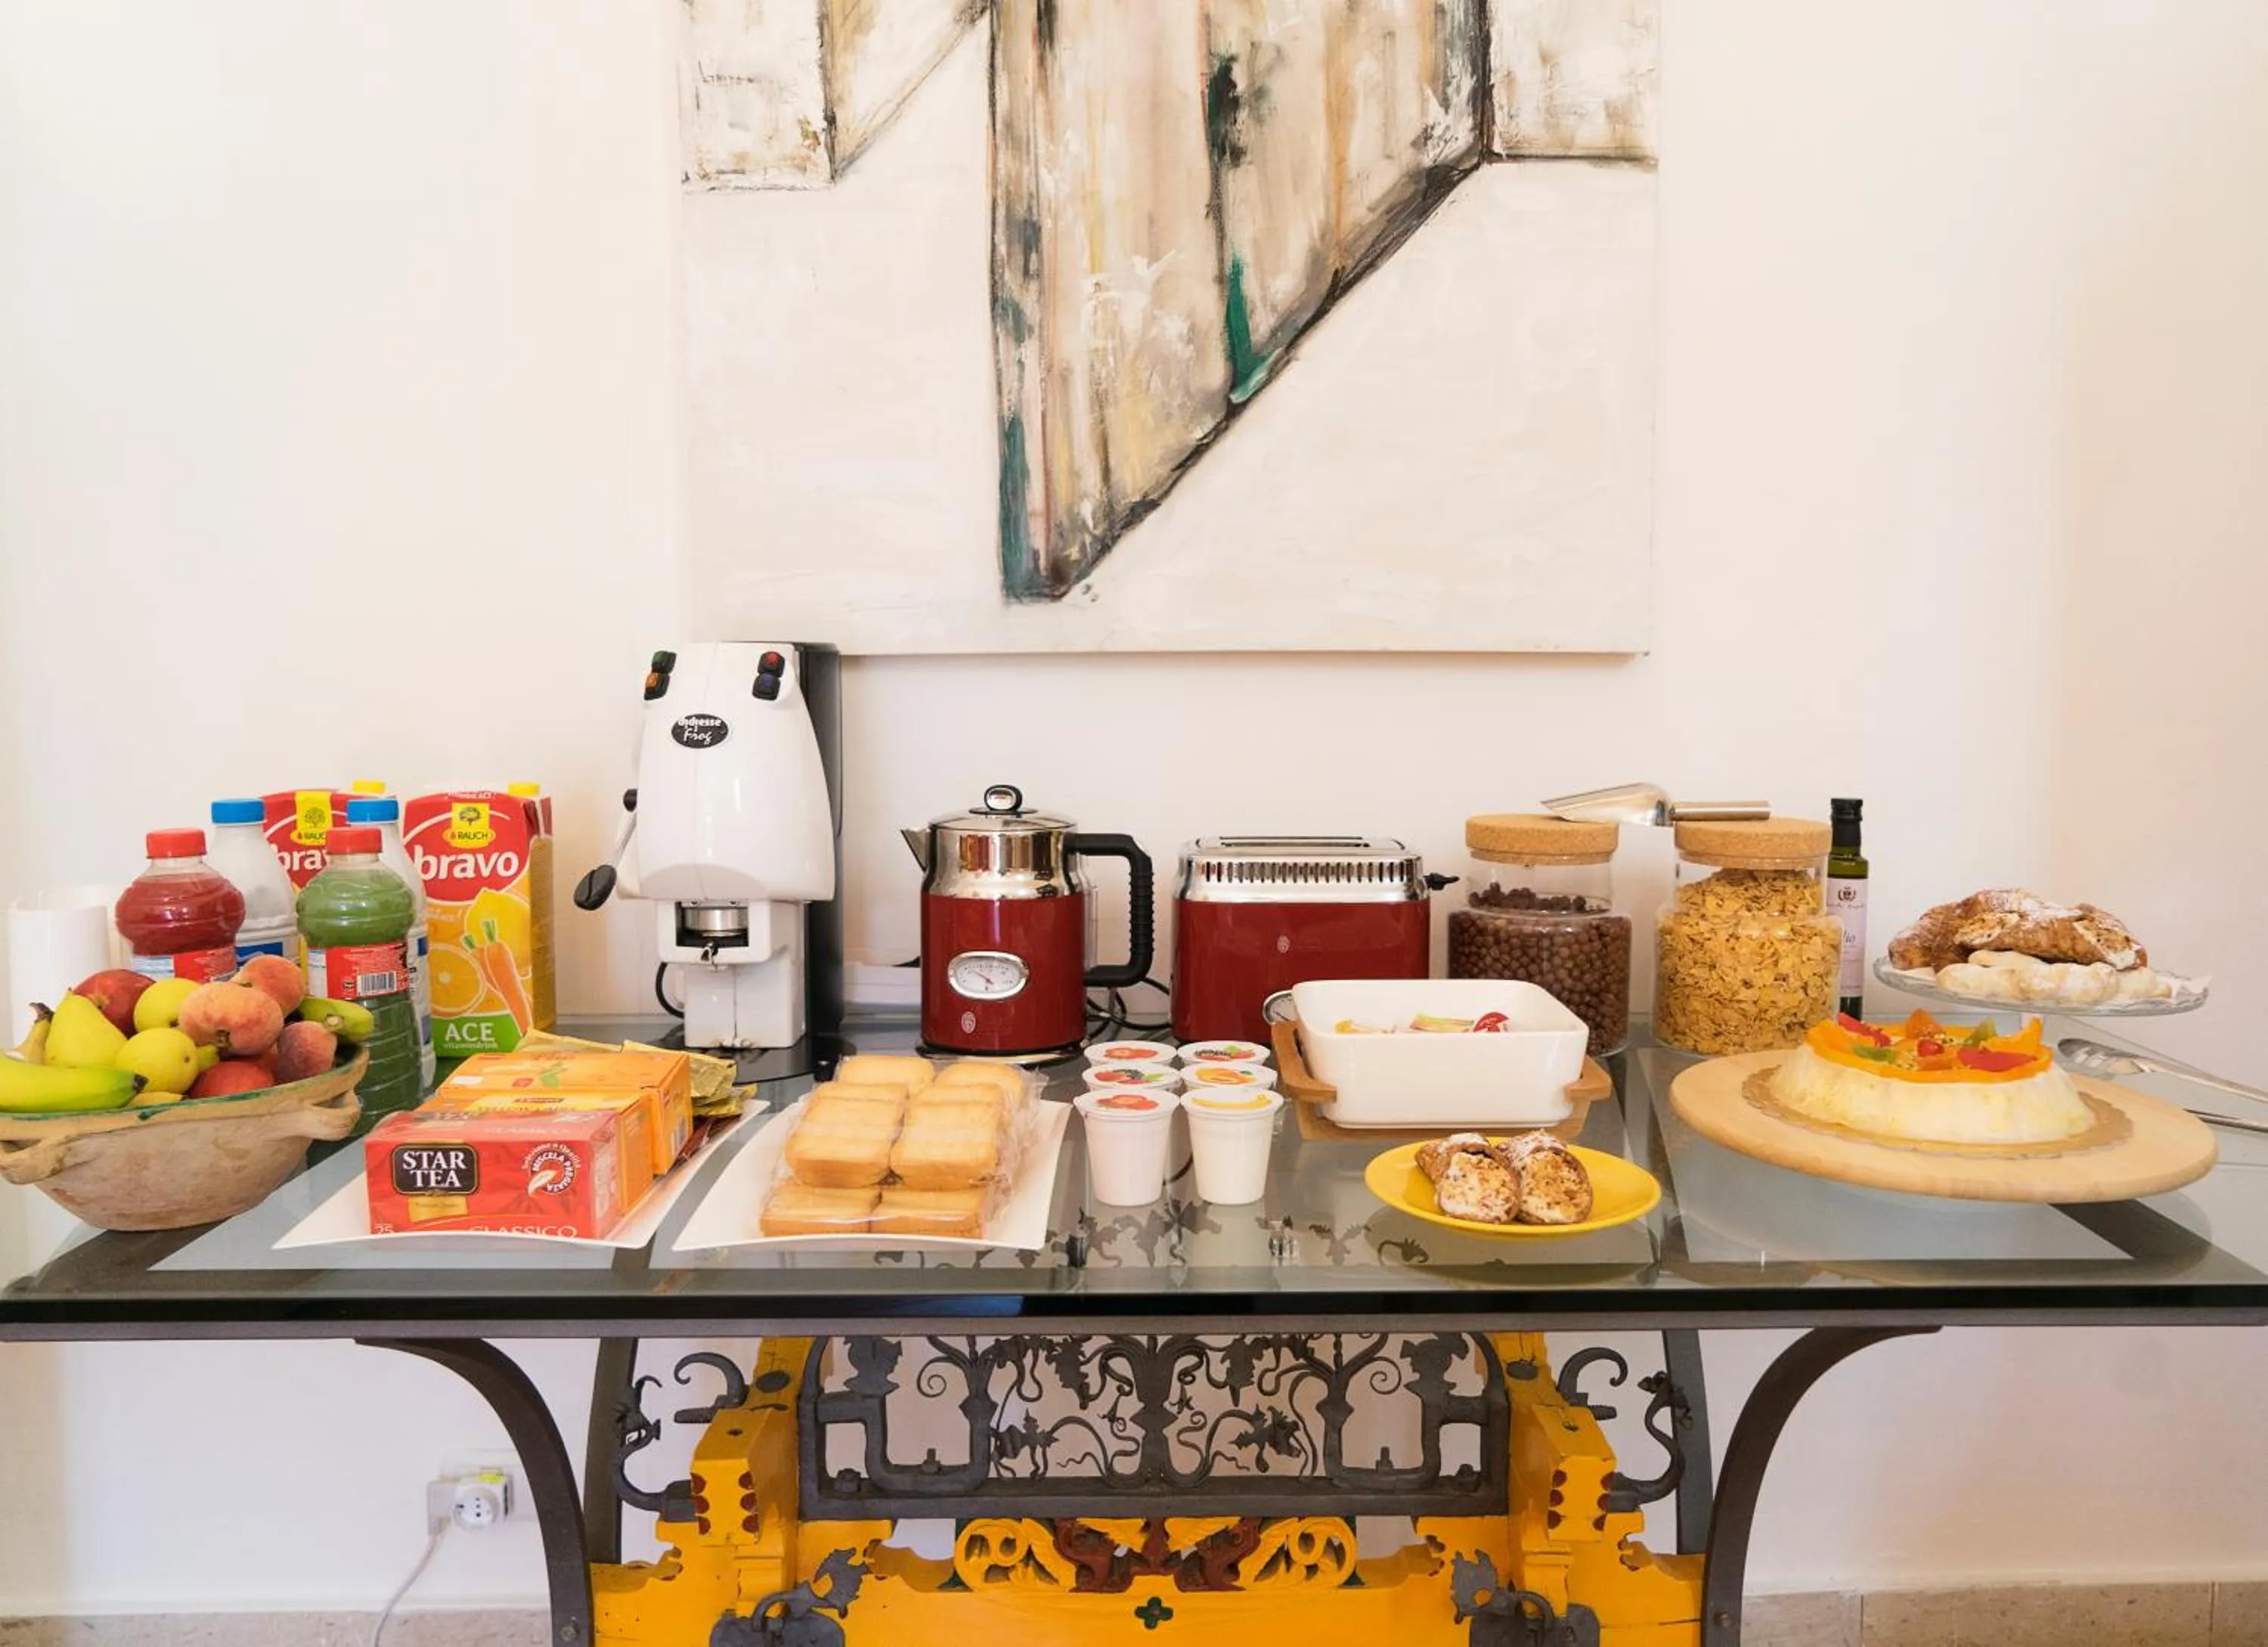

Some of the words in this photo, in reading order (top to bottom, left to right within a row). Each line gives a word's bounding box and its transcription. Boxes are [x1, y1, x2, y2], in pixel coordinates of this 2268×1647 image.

[457, 831, 488, 840] RAUCH
[271, 843, 327, 871] bra
[414, 845, 519, 881] bravo
[445, 1022, 495, 1042] ACE
[402, 1150, 467, 1169] STAR
[410, 1169, 462, 1187] TEA
